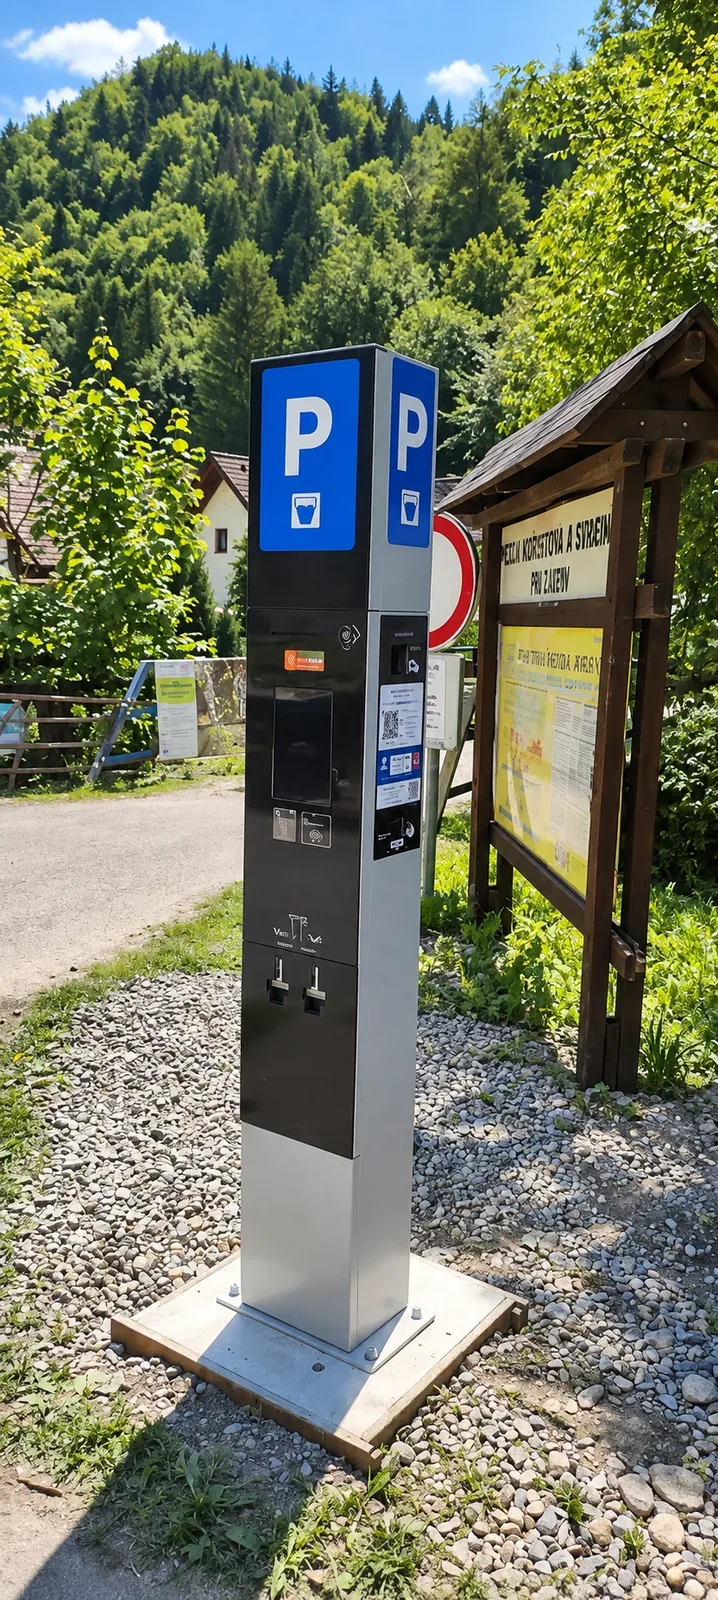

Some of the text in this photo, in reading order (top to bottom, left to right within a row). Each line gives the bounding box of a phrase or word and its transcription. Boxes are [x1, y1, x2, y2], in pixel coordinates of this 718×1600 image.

[284, 396, 333, 477] P
[397, 392, 428, 472] P
[566, 524, 573, 553] A
